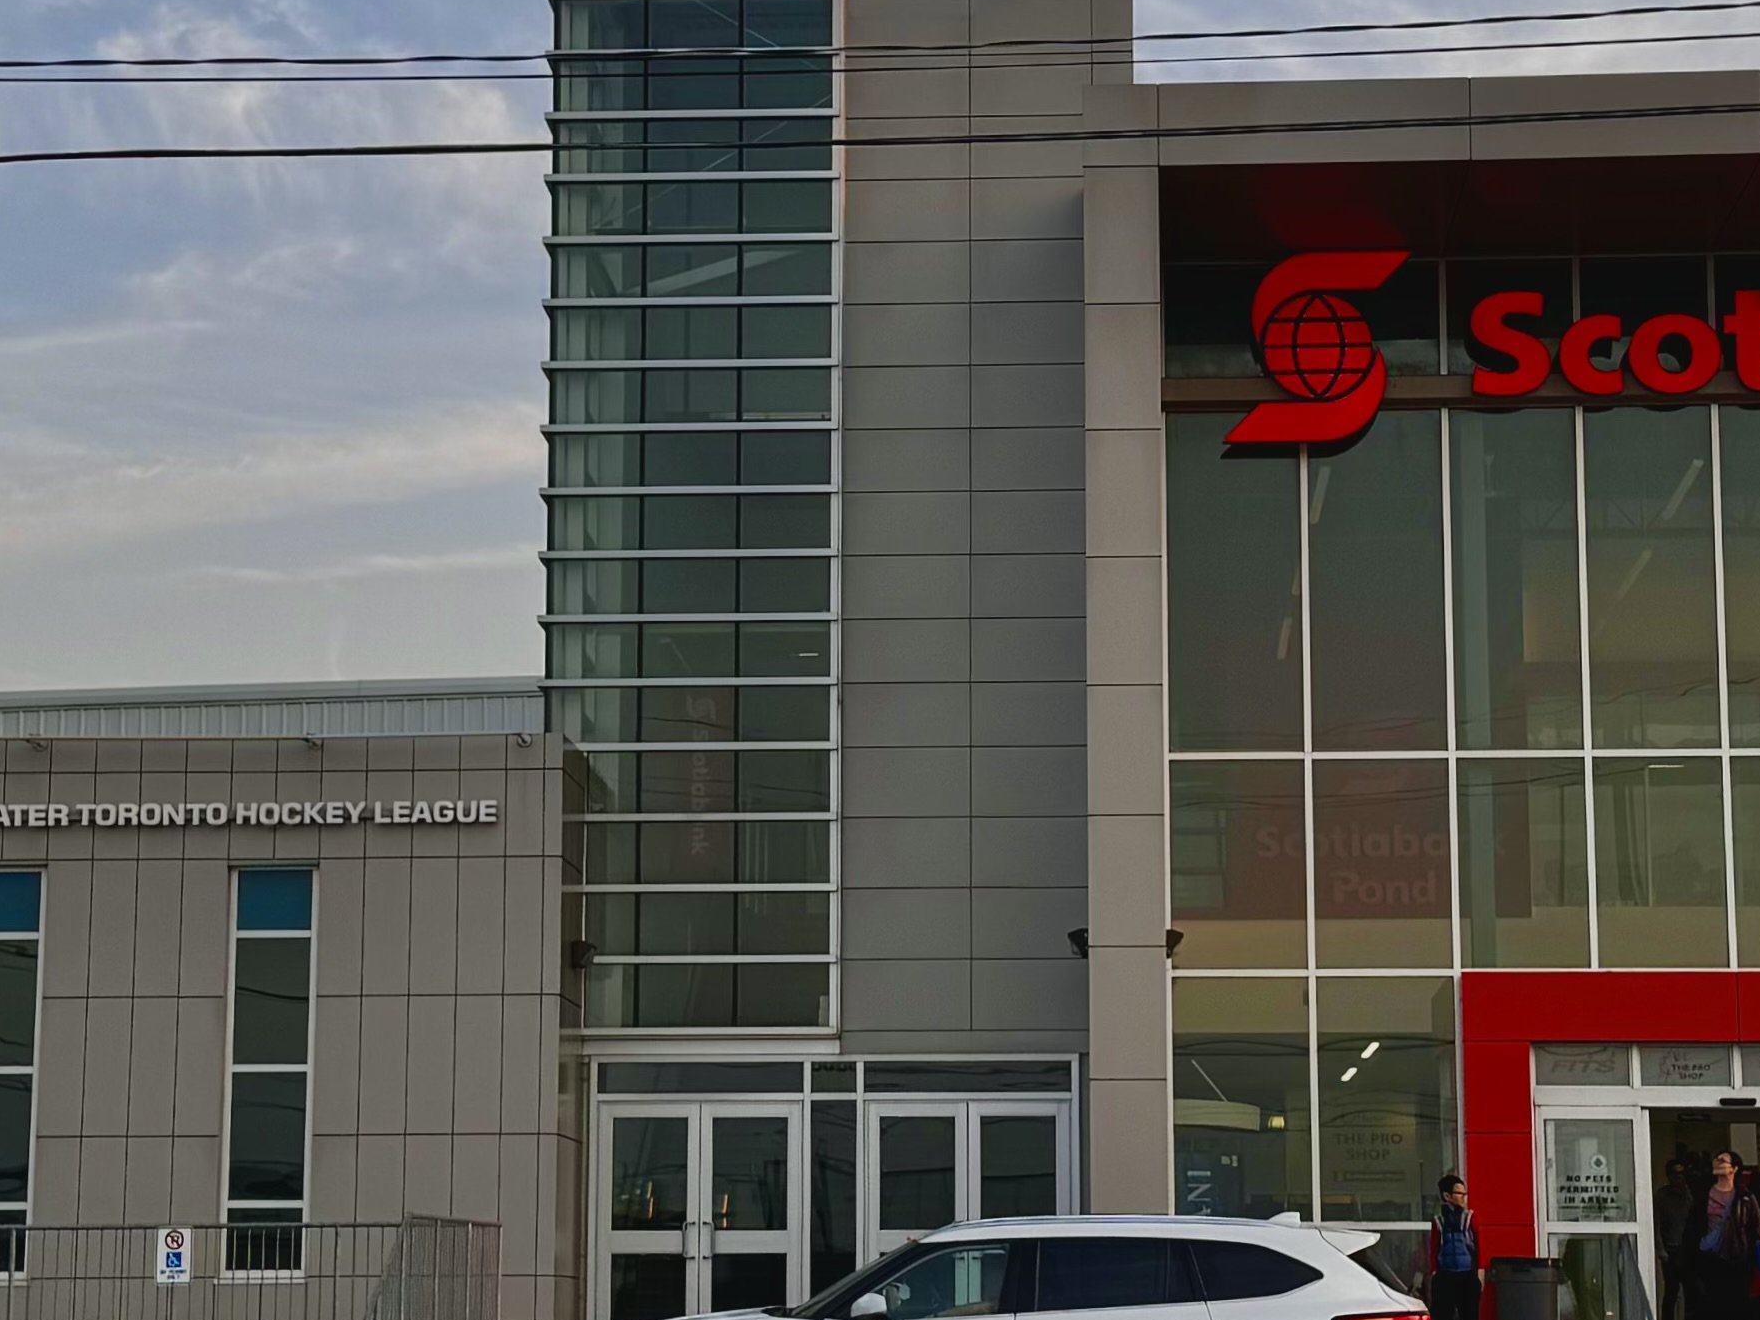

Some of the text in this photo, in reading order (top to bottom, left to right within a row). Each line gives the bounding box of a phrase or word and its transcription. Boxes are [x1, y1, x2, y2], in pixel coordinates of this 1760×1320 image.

[76, 803, 228, 826] TORONTO
[235, 801, 367, 825] HOCKEY
[373, 799, 499, 823] LEAGUE
[1330, 869, 1440, 906] Pond
[1345, 1148, 1391, 1160] SHOP
[1564, 1196, 1616, 1204] IN ARENA
